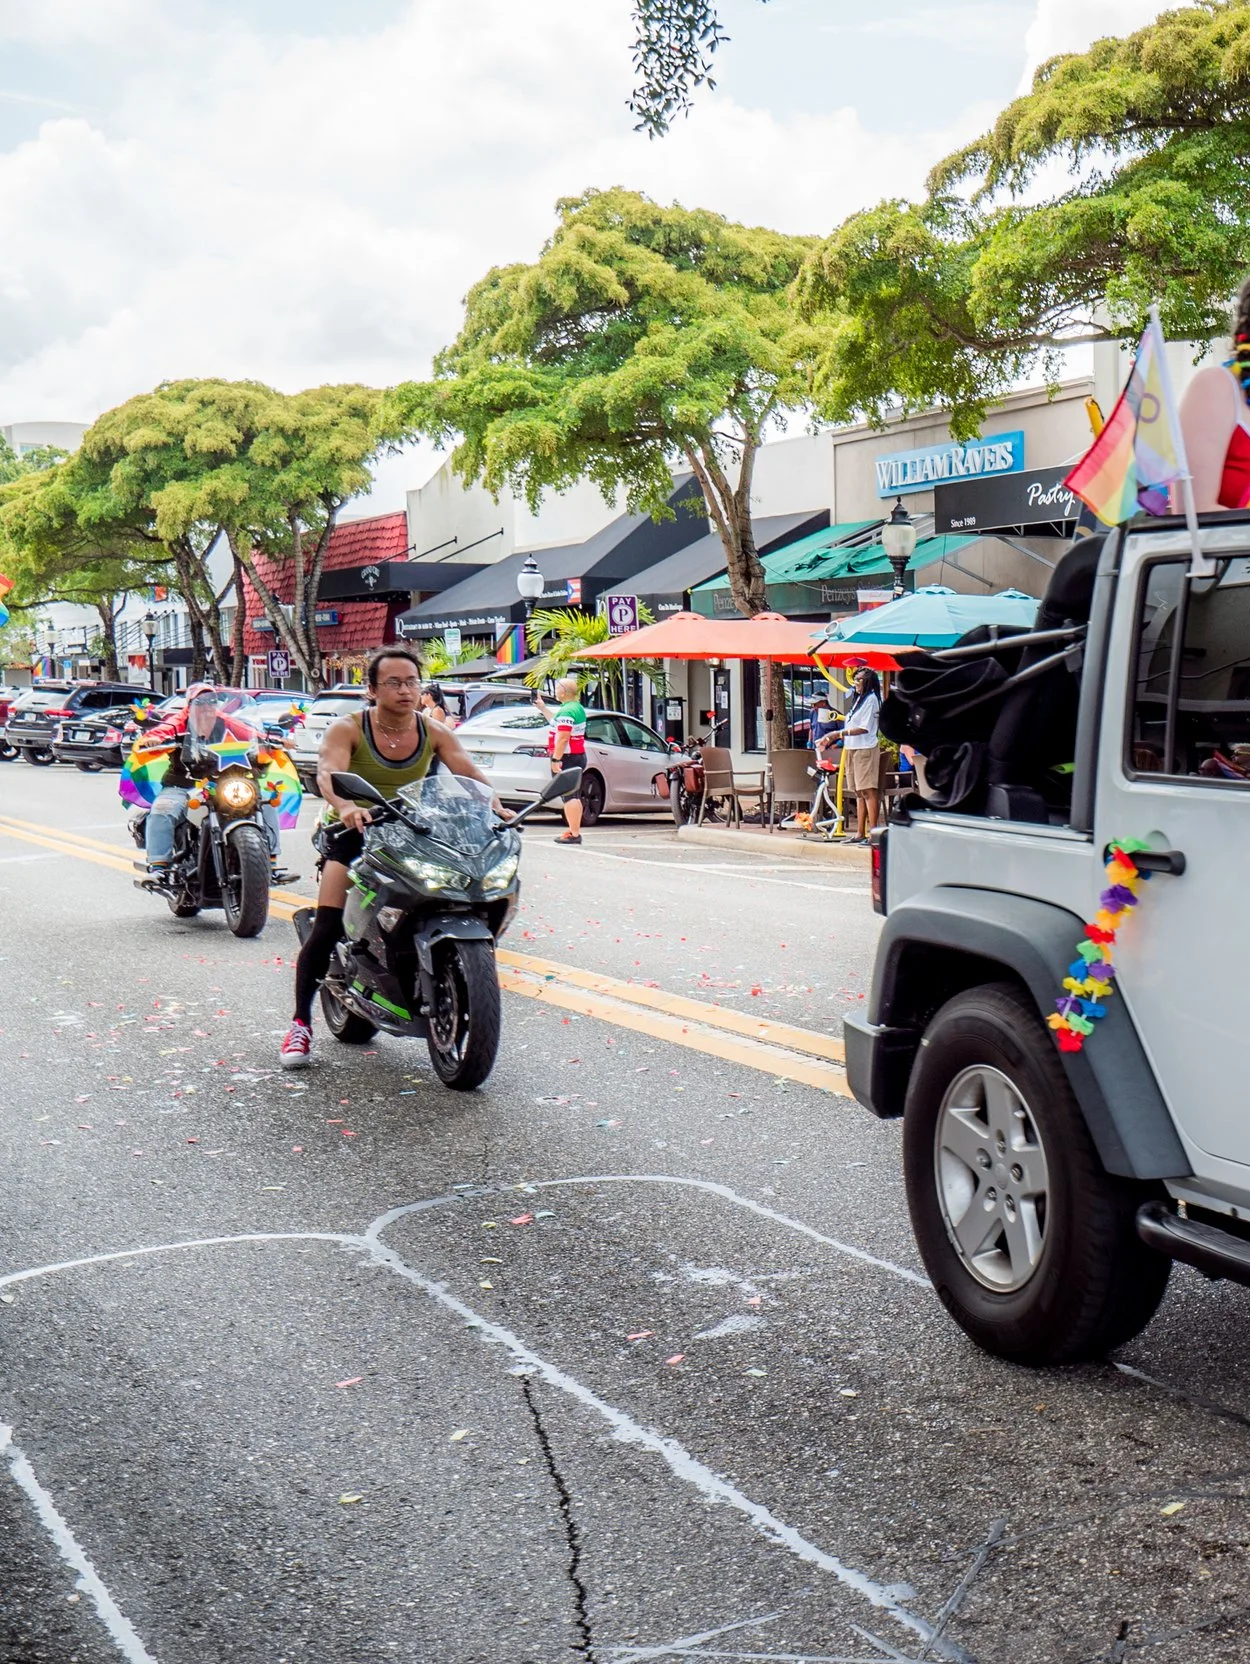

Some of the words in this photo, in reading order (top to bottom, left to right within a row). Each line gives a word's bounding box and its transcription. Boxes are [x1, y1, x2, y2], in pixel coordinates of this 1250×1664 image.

[875, 453, 950, 490] WILLIAM
[951, 441, 1014, 476] RAVEIS
[1027, 482, 1076, 516] Pastry
[950, 519, 964, 528] Since
[964, 516, 976, 526] 1989
[611, 625, 636, 633] HERE
